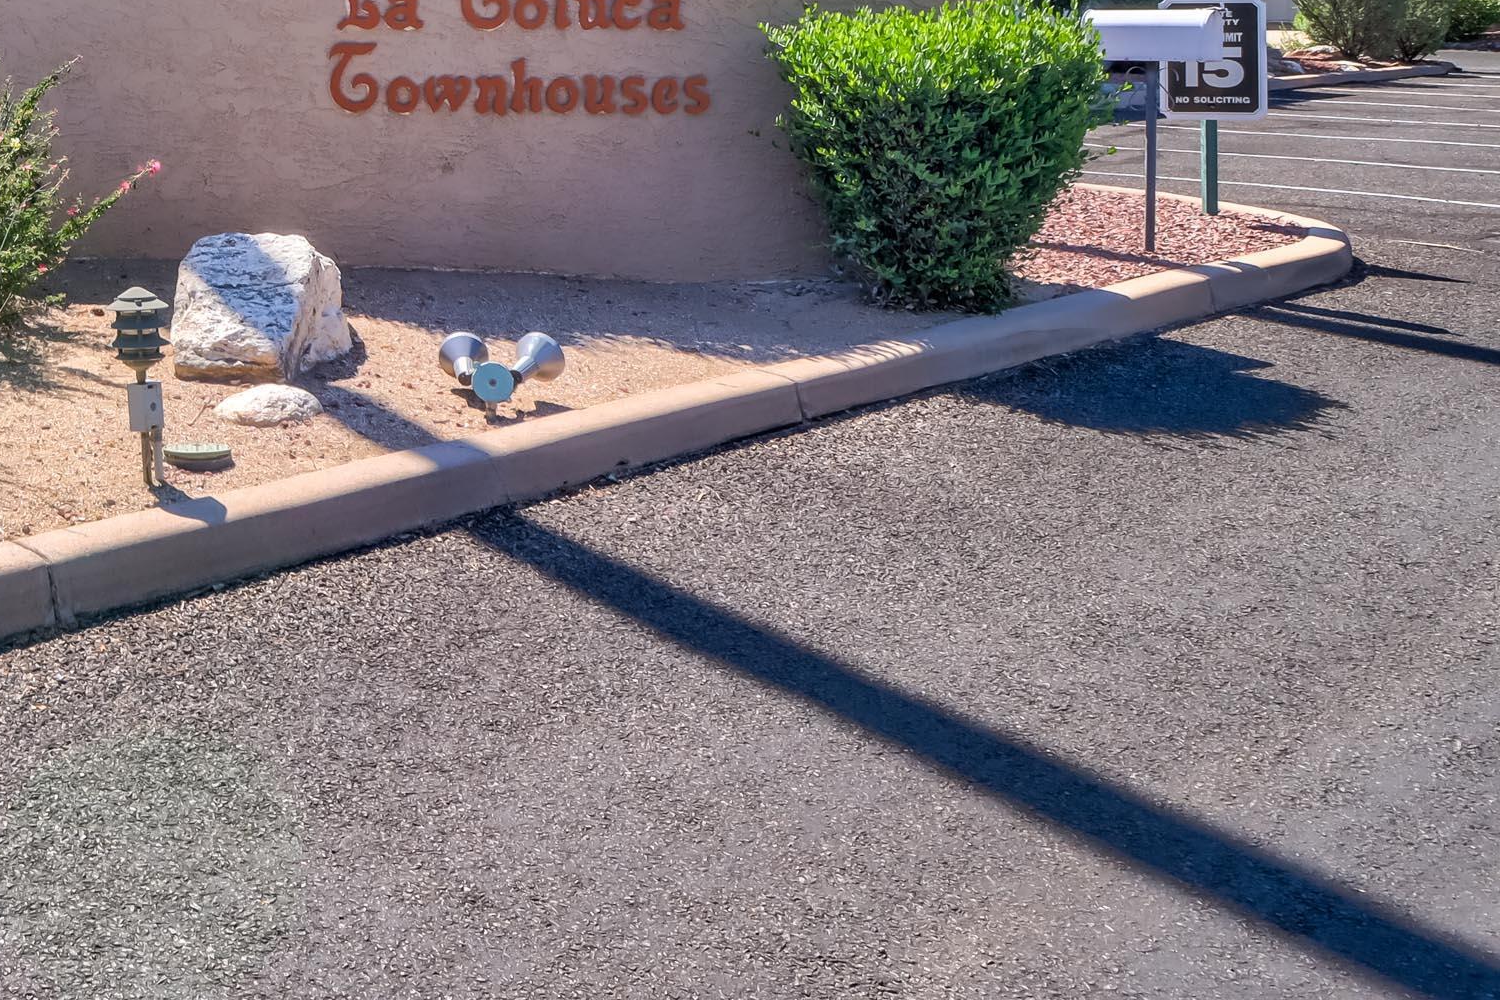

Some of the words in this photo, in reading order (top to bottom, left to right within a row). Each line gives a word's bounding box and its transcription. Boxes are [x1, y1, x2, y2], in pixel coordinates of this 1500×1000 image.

[329, 42, 712, 116] Townhouses
[1185, 46, 1244, 88] 15
[1175, 96, 1190, 104] NO
[1193, 96, 1251, 104] SOLICITING
